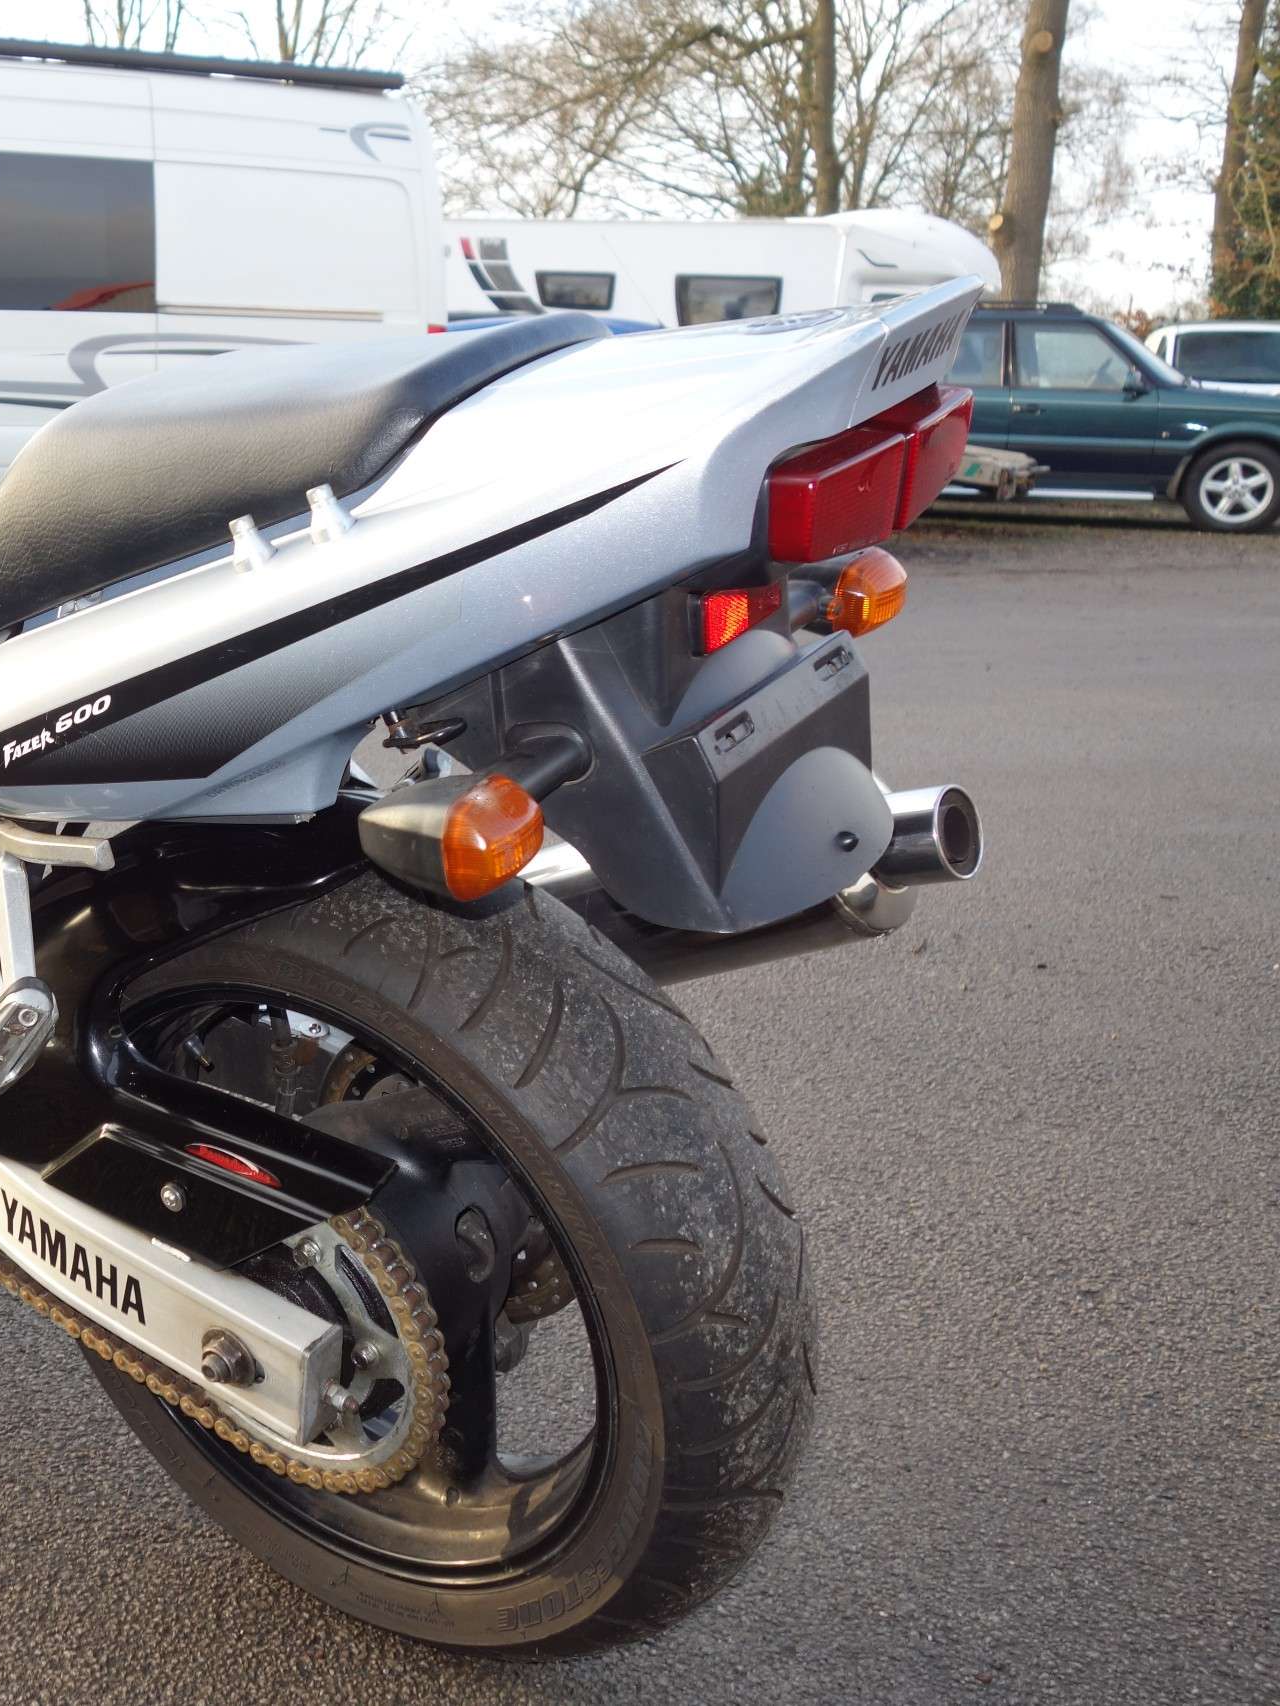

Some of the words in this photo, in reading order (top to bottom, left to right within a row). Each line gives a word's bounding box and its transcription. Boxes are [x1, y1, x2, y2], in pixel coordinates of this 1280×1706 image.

[871, 309, 966, 392] YAMAHA
[55, 694, 112, 734] 600
[0, 1187, 147, 1326] YAMAHA
